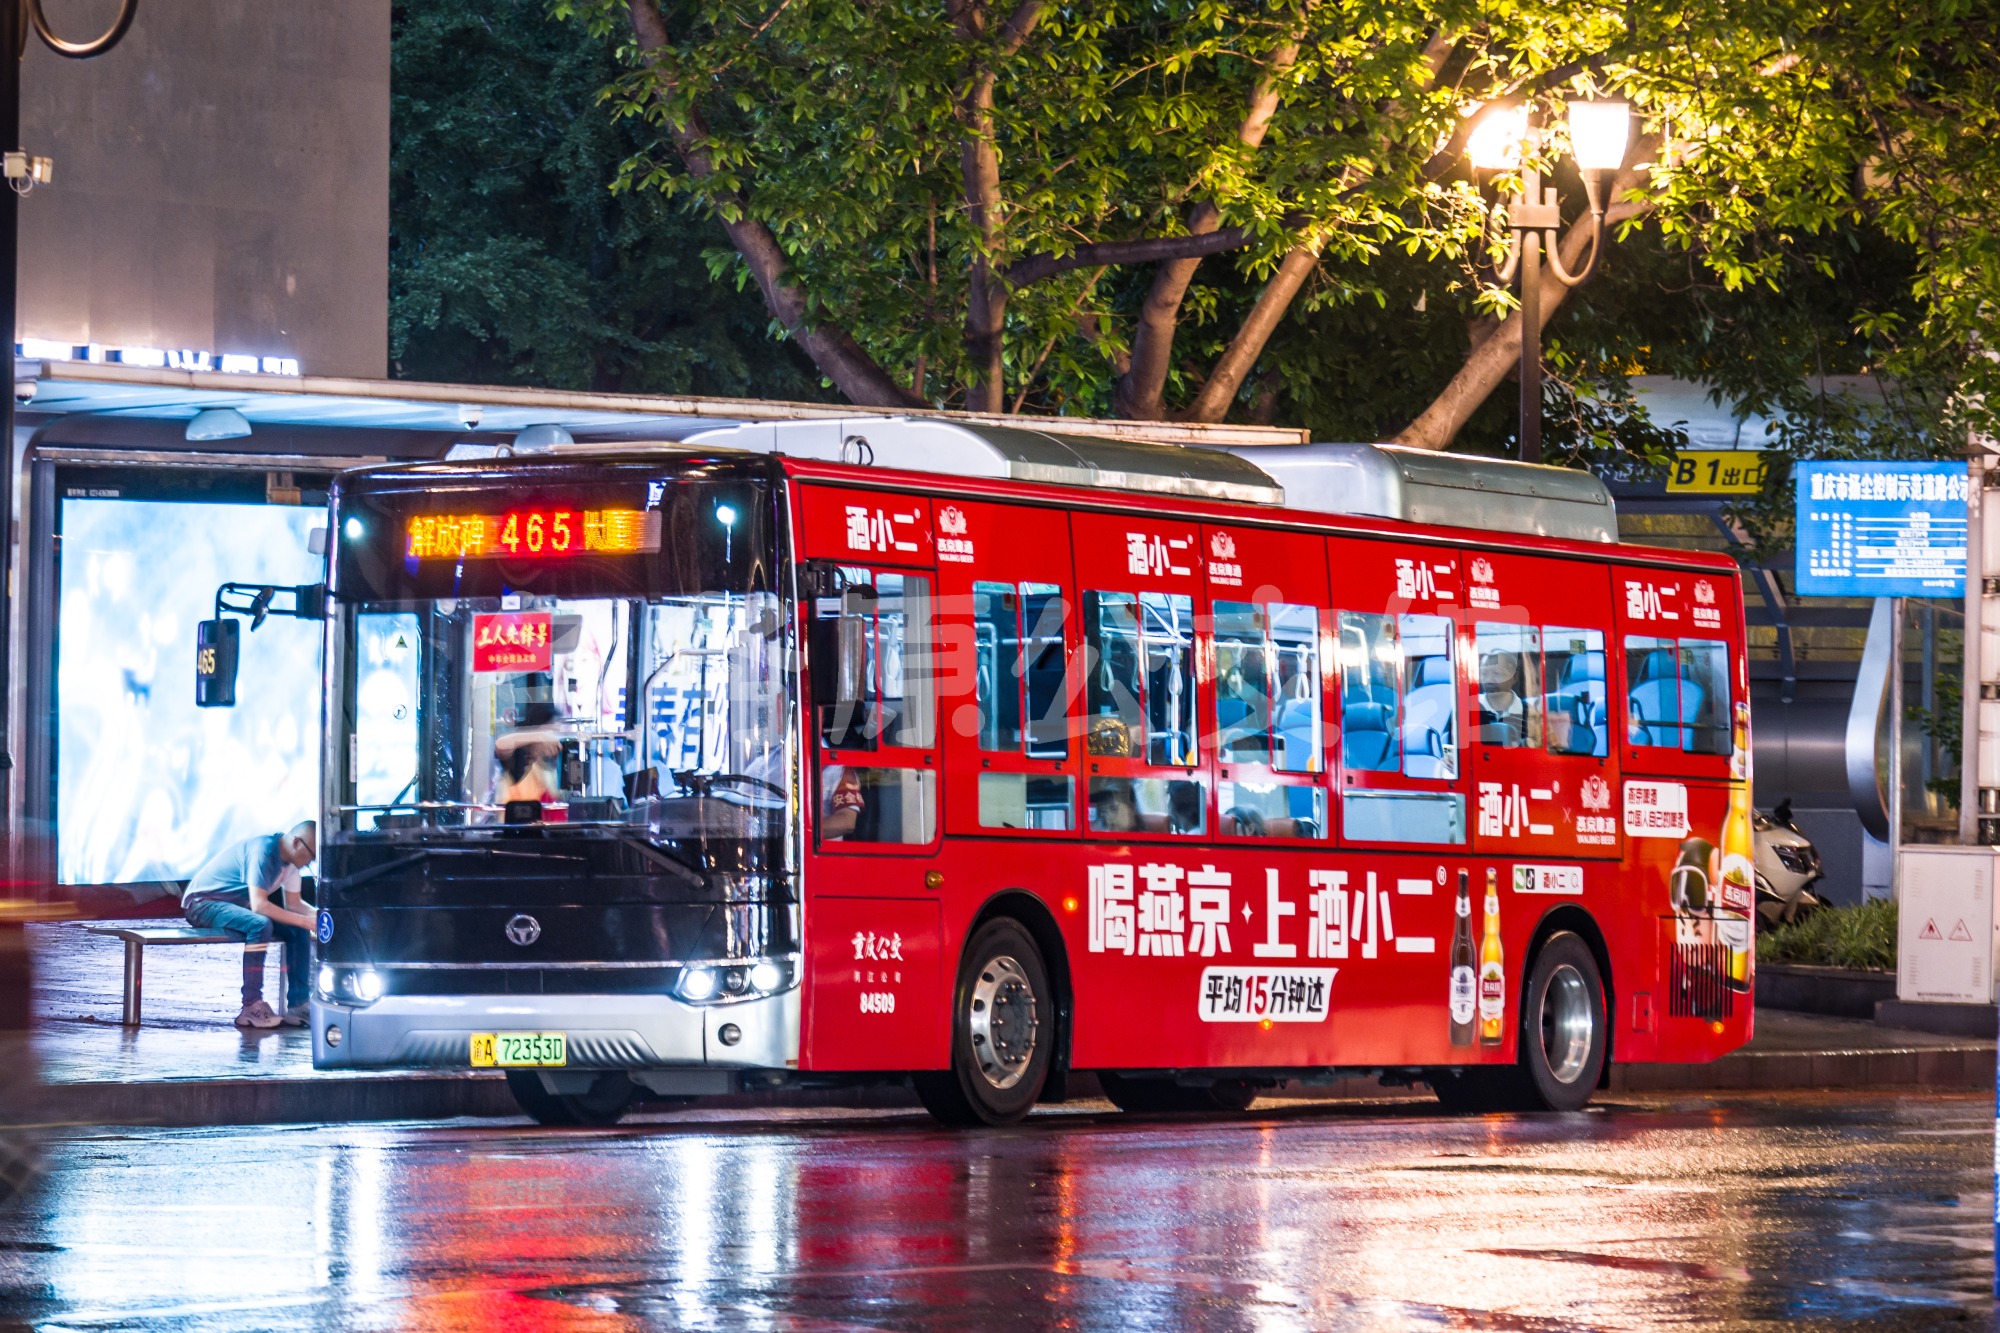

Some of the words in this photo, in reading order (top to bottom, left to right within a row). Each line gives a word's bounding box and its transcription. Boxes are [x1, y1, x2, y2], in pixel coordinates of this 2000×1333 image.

[408, 514, 484, 557] 解放碑
[501, 511, 571, 553] 465
[845, 505, 918, 552] 酒小二
[1126, 532, 1191, 576] 酒小二
[1395, 558, 1454, 600] 酒小二
[1625, 581, 1679, 620] 酒小二
[477, 622, 548, 648] 工人先锋号
[1478, 782, 1554, 837] 酒小二
[1628, 787, 1658, 806] 燕京啤酒
[1576, 815, 1616, 834] 燕京啤酒
[1627, 810, 1685, 829] 中国人自己的啤酒
[1543, 871, 1567, 889] 酒小二
[851, 931, 903, 961] 重庆公交
[860, 992, 895, 1014] 84509
[1205, 975, 1325, 1015] 平均15分钟达
